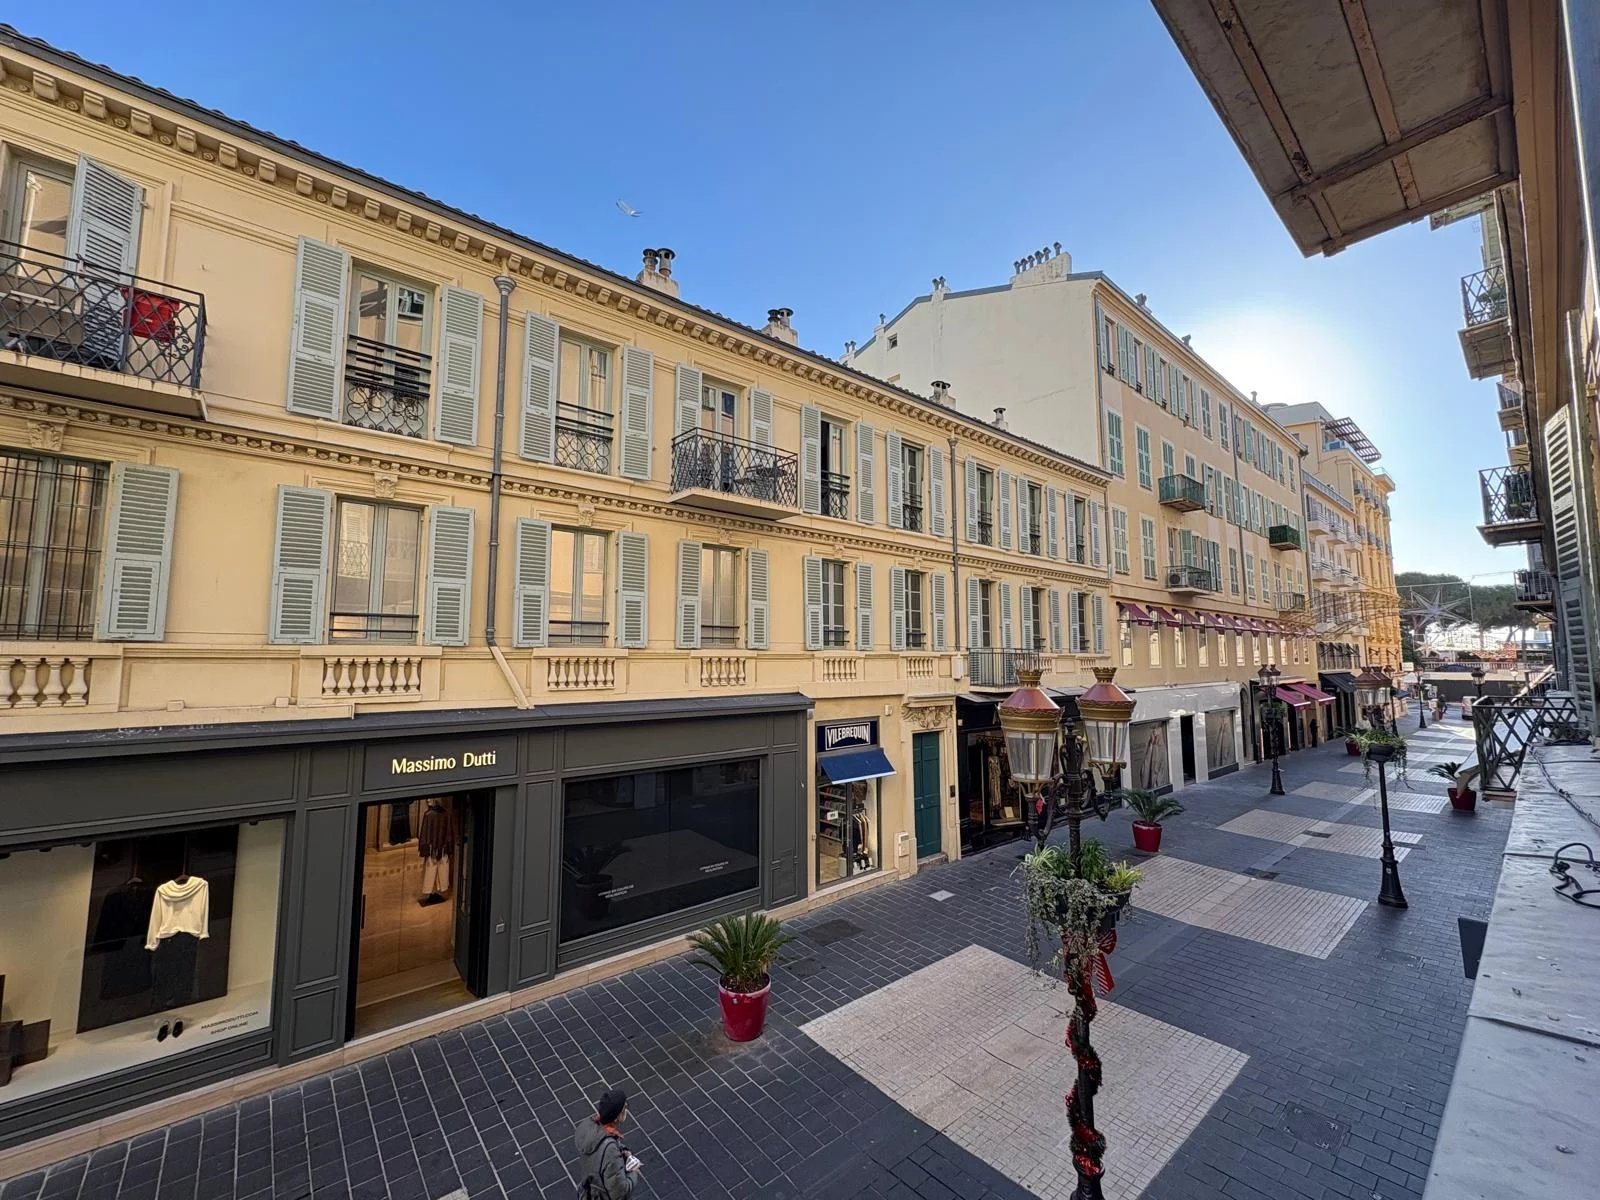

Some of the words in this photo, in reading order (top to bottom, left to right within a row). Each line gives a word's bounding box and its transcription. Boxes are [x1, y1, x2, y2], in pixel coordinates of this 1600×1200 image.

[827, 725, 869, 748] VILEBREQUIN
[391, 756, 456, 774] Massimo
[463, 750, 497, 767] Dutti
